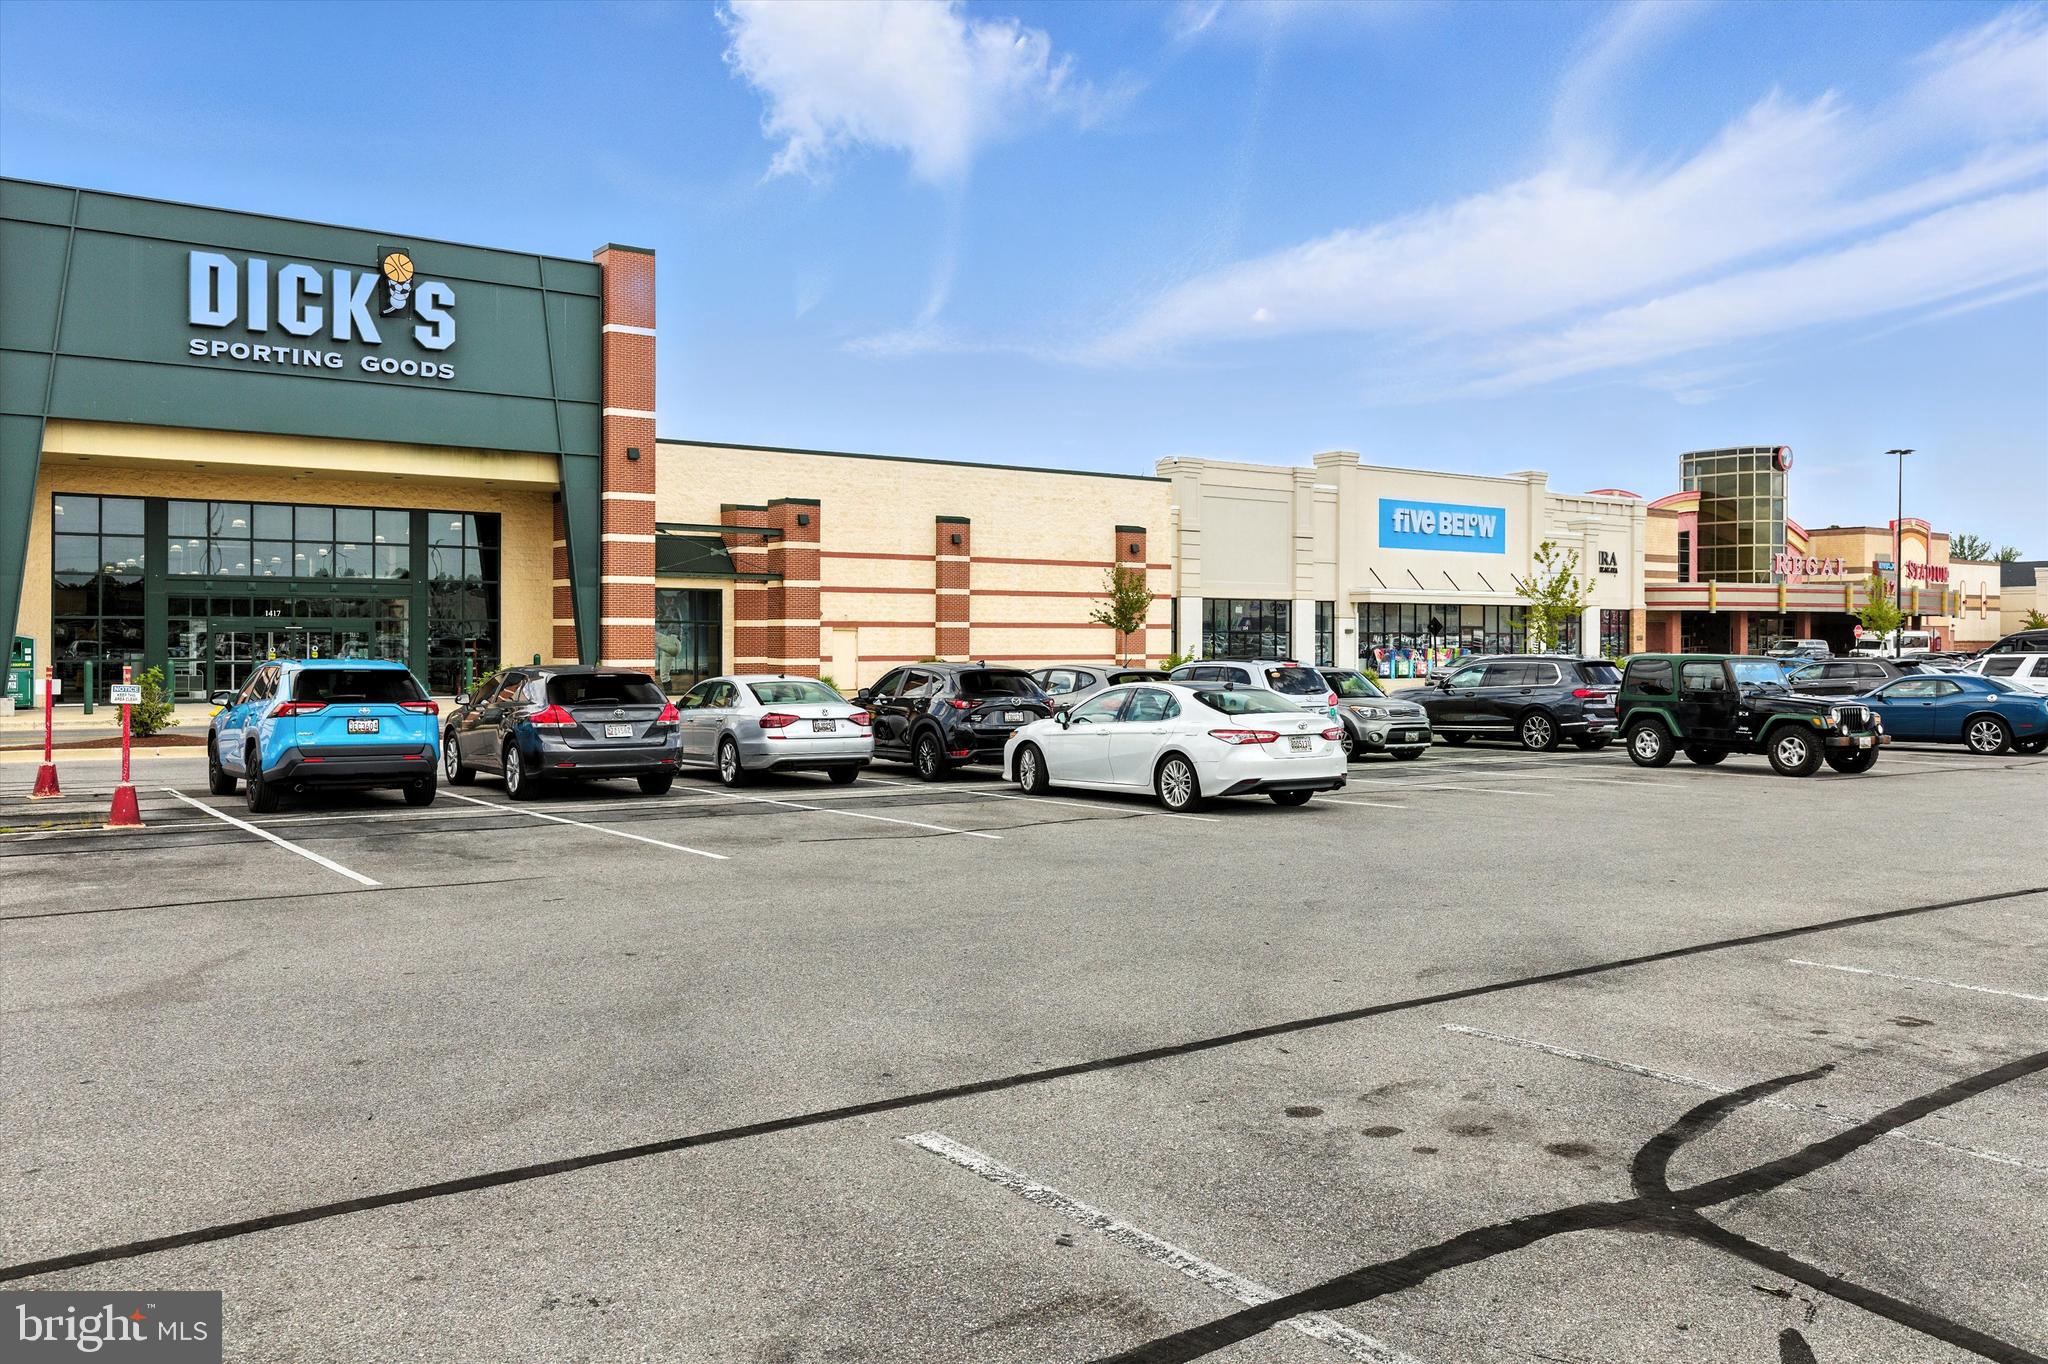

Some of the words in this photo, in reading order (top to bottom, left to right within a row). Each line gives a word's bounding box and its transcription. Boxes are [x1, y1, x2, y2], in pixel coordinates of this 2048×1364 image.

[188, 250, 456, 351] DICK'S
[189, 338, 343, 369] SPORTING
[361, 355, 456, 380] GOODS
[1773, 553, 1848, 576] REGAL
[113, 685, 140, 693] NOTICE
